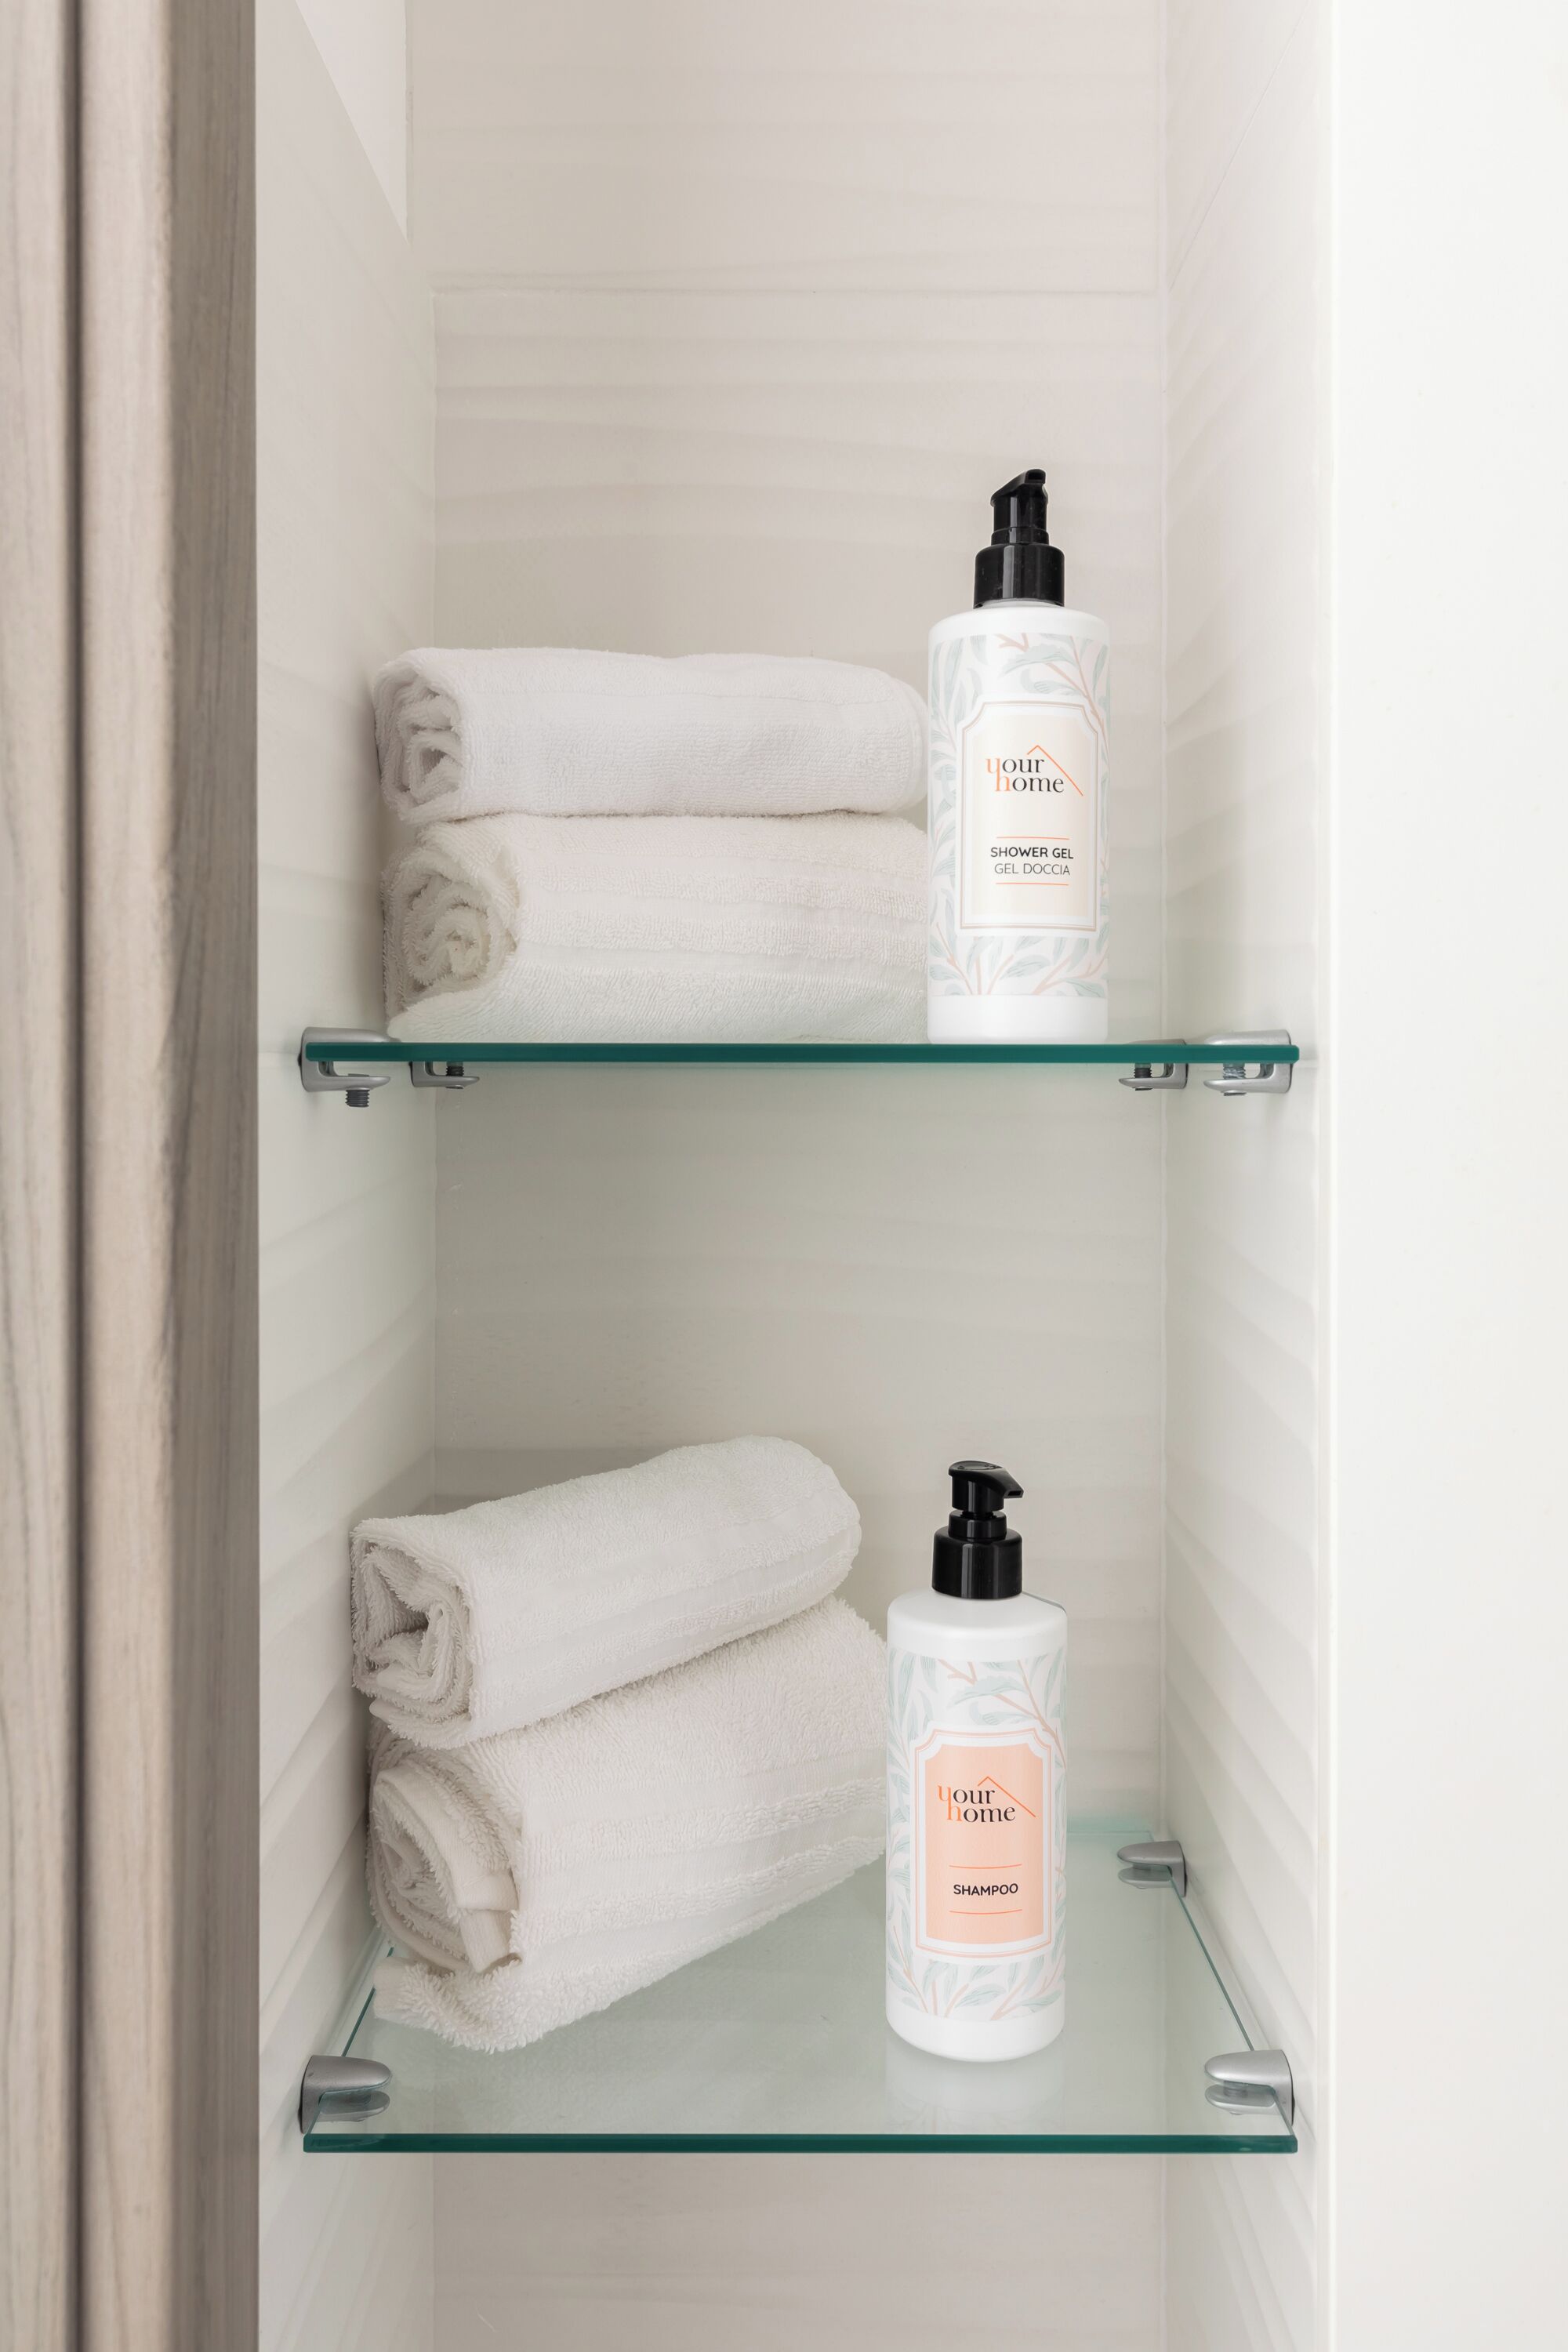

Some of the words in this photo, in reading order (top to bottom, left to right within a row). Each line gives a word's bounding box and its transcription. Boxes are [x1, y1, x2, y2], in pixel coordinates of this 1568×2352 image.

[985, 758, 1044, 779] your
[995, 773, 1065, 793] home
[990, 847, 1048, 858] SHOWER
[1052, 848, 1074, 859] GEL
[994, 863, 1018, 874] GEL
[1023, 863, 1070, 875] DOCCIA
[938, 1785, 995, 1807] your
[947, 1805, 1015, 1823] home
[953, 1883, 1018, 1896] SHAMPOO
